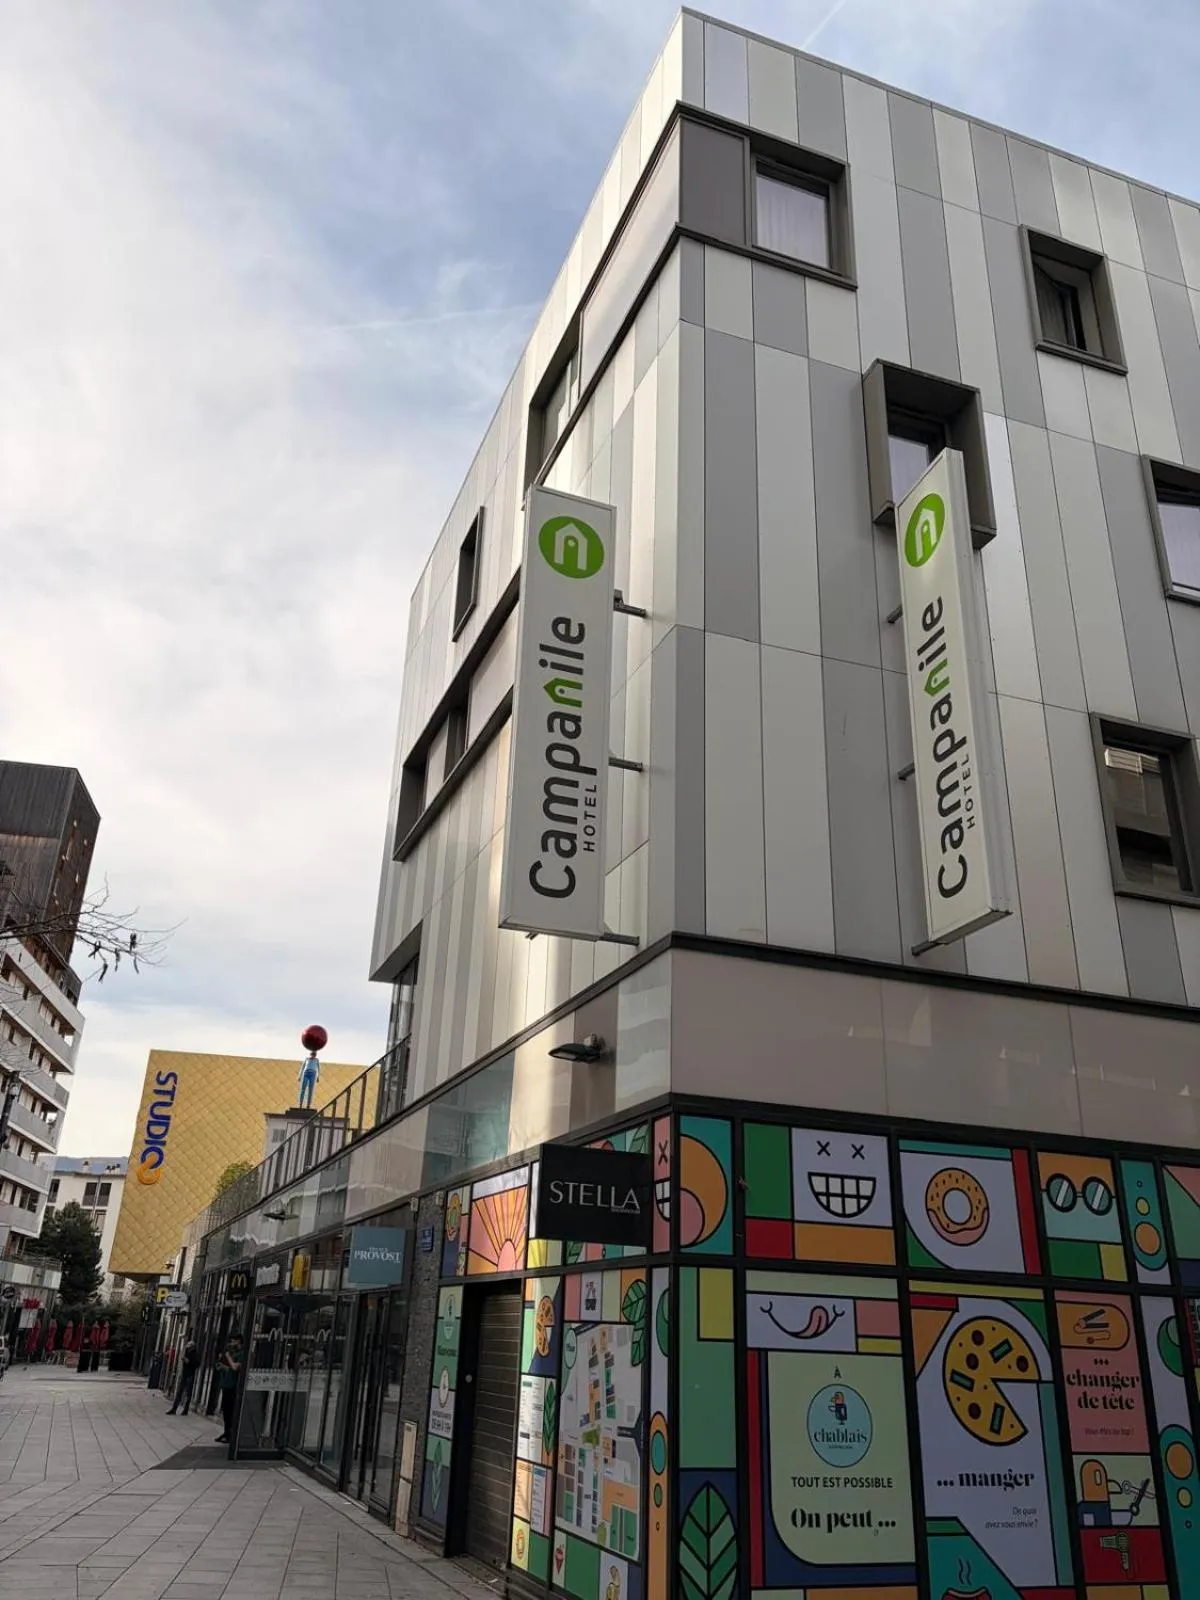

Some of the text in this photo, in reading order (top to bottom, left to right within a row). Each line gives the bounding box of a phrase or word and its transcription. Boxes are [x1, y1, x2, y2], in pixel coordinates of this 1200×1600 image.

[529, 615, 598, 900] Campanile
[919, 595, 969, 900] Campanile
[959, 753, 975, 829] HOTEL
[583, 783, 597, 852] HOTEL
[549, 1180, 640, 1210] STELLA
[354, 1249, 401, 1261] PROVOST
[834, 1366, 842, 1379] À
[1066, 1368, 1140, 1391] changer
[1078, 1391, 1135, 1410] de tête
[813, 1427, 868, 1443] chablais
[791, 1476, 893, 1488] TOUT EST POSSIBLE
[958, 1468, 1035, 1491] manger
[791, 1508, 821, 1528] On
[827, 1509, 873, 1534] peut
